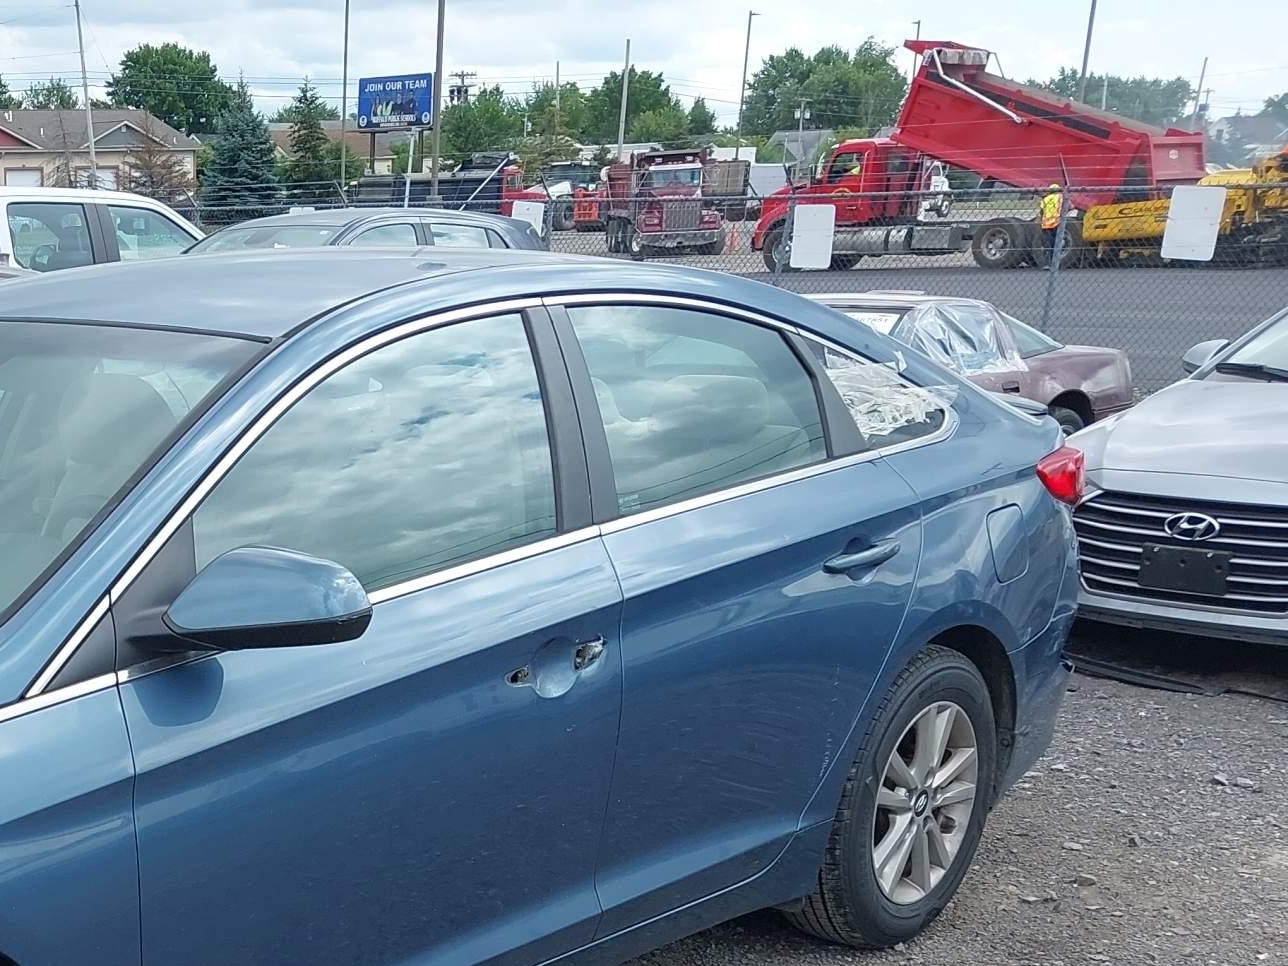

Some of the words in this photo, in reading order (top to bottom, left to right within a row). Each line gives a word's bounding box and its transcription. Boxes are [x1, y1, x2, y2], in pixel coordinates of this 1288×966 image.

[365, 83, 383, 92] JOIN
[385, 81, 402, 90] OUR
[405, 79, 427, 89] TEAM
